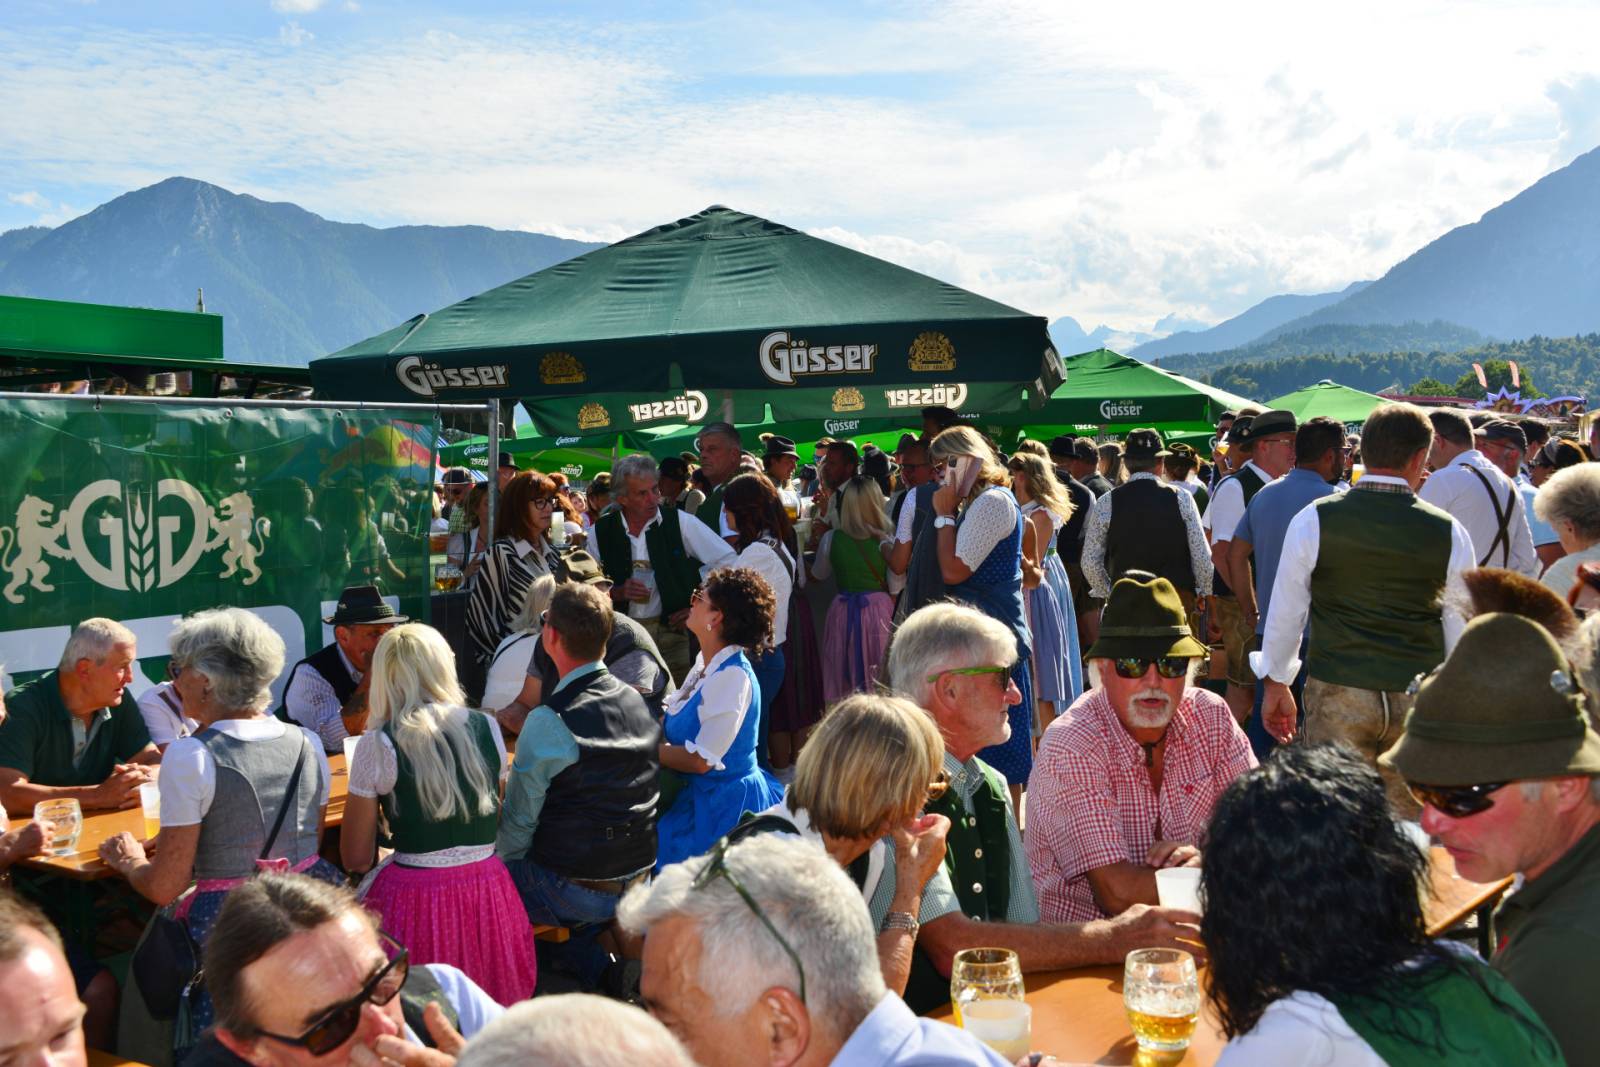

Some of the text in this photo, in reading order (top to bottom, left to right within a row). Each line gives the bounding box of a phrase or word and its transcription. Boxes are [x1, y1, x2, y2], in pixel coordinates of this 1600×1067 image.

[759, 331, 878, 385] Gösser
[395, 355, 508, 396] Gösser
[1100, 399, 1143, 420] Gösser
[824, 419, 860, 435] Gösser
